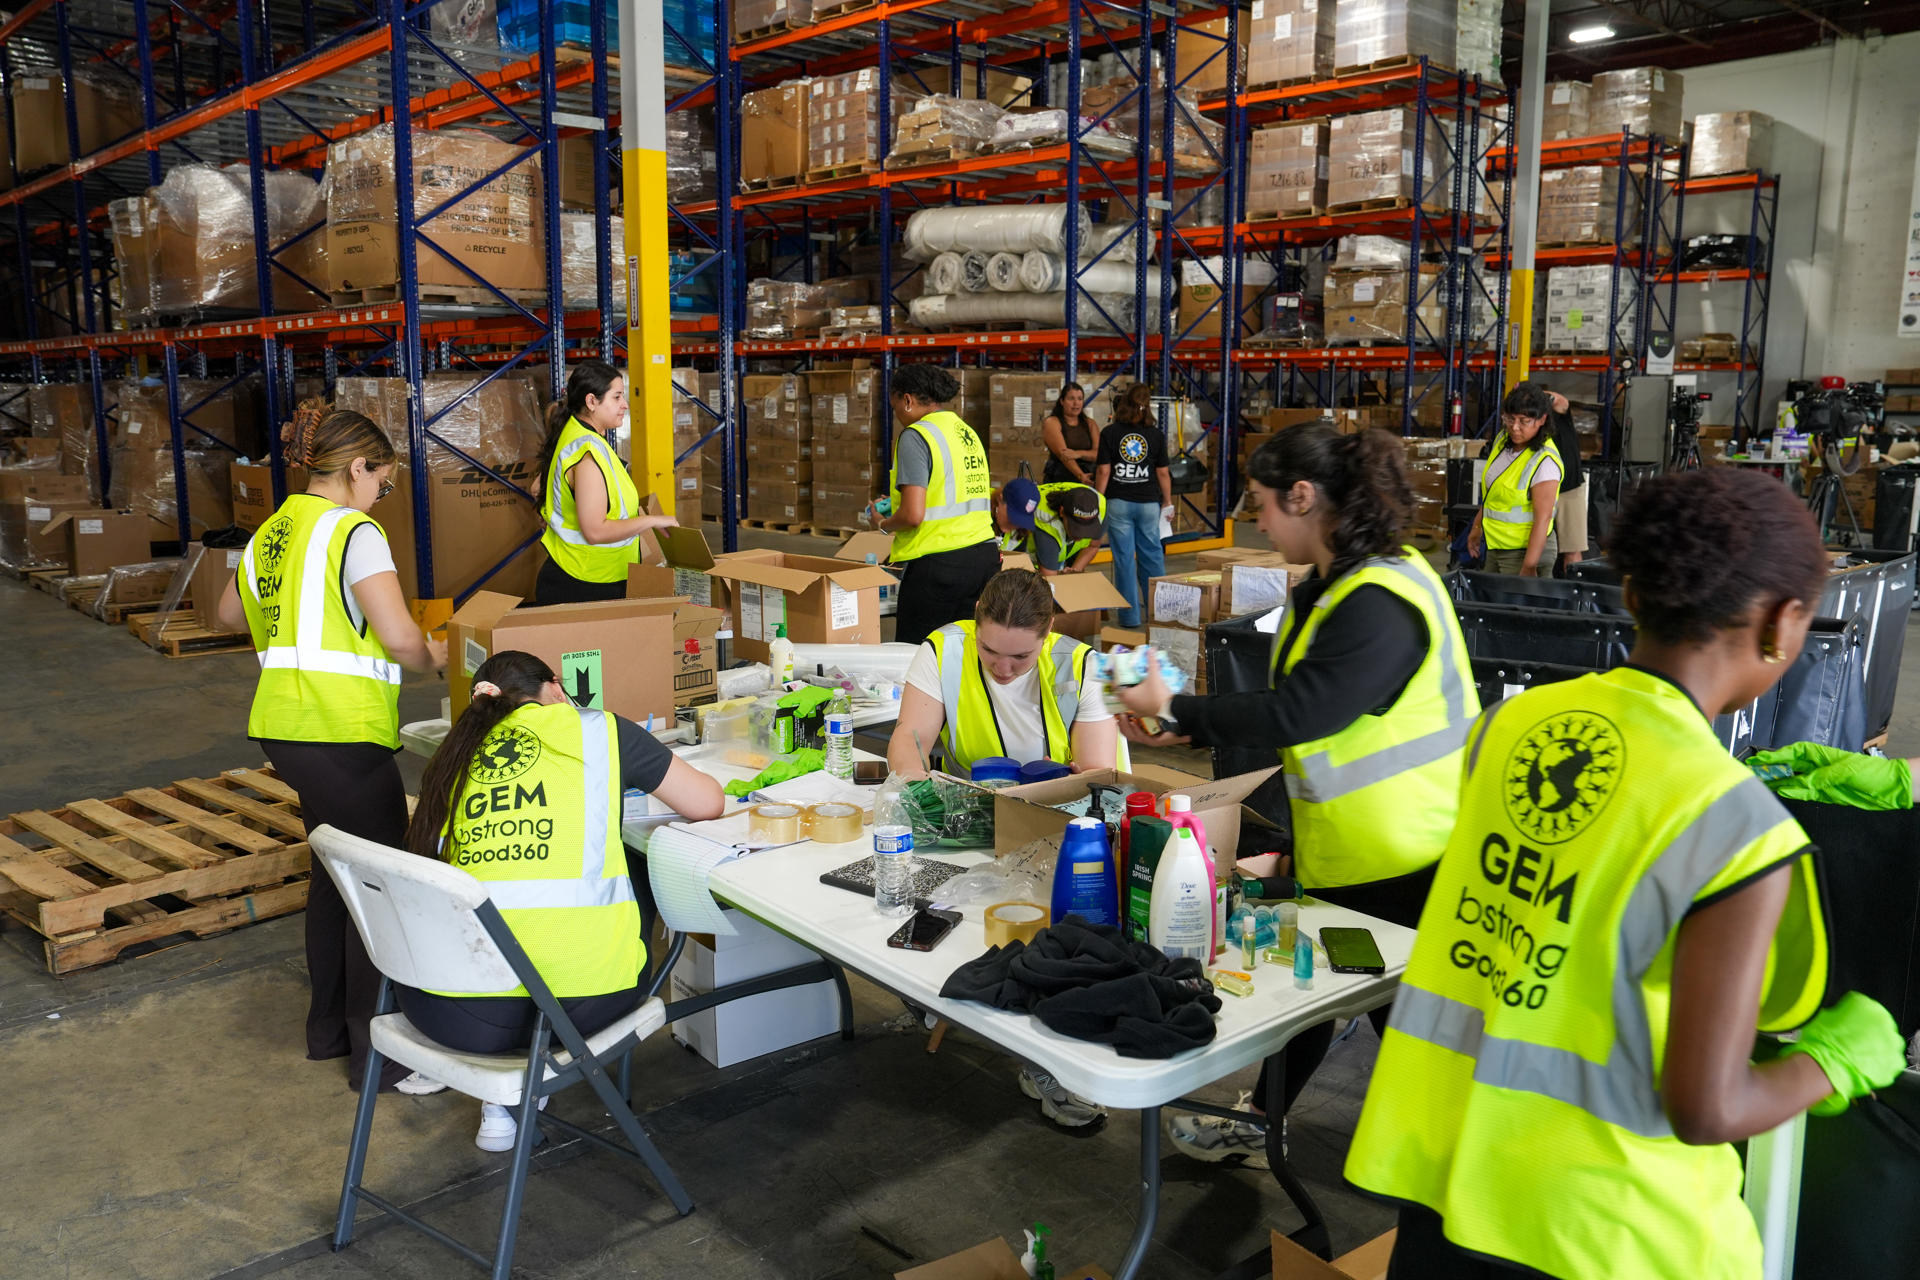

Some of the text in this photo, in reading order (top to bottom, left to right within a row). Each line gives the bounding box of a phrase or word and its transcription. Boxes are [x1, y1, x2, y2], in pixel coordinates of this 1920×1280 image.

[473, 244, 507, 254] RECYCLE
[963, 455, 985, 470] GEM
[1114, 462, 1150, 478] GEM
[459, 462, 529, 485] DHL
[461, 489, 481, 498] DHL
[465, 780, 548, 820] GEM
[459, 818, 553, 846] bstrong
[457, 843, 549, 866] Good360
[1132, 870, 1152, 882] SPRING
[1134, 863, 1150, 874] IRISH
[1480, 832, 1579, 925] GEM
[1450, 940, 1548, 1011] Go60
